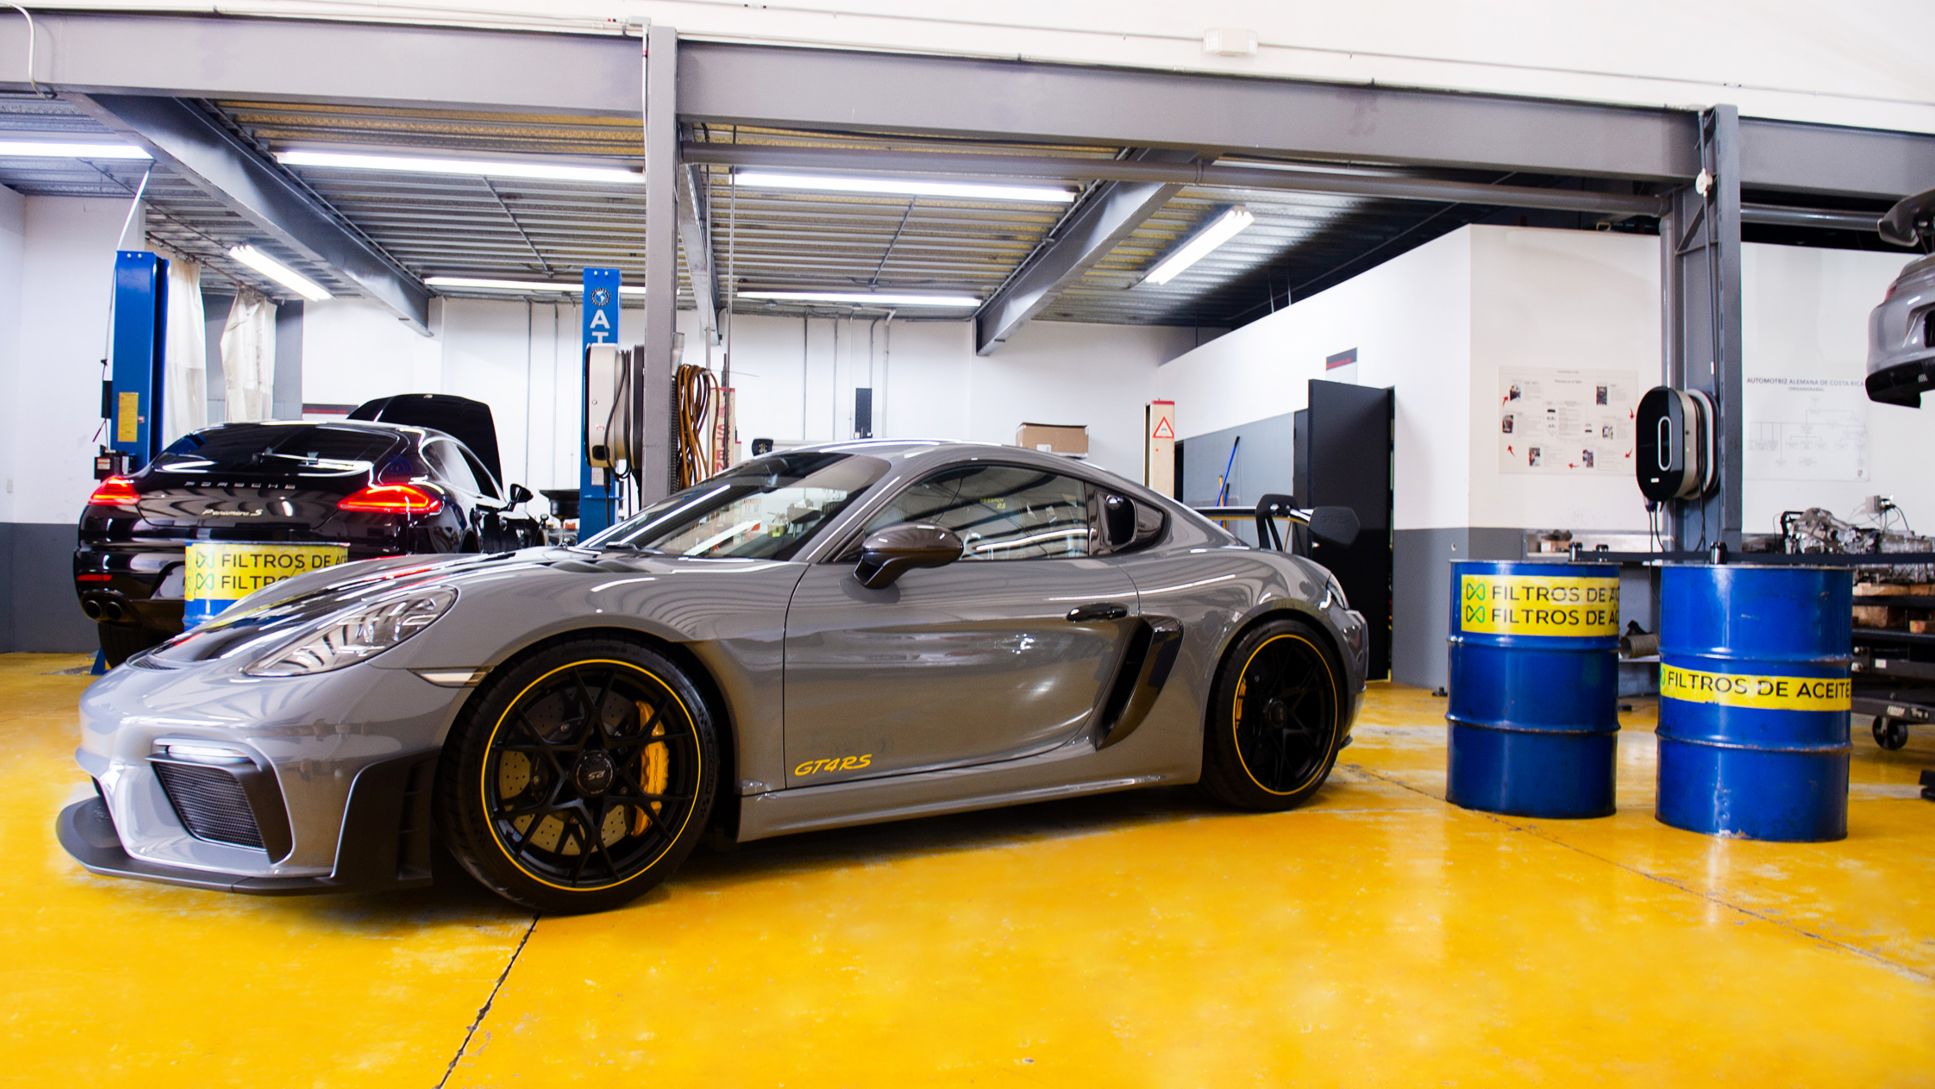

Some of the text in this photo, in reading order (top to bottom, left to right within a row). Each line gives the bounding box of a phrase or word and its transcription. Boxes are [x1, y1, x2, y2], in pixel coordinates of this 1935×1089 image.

[1789, 378, 1819, 386] ALEMANA
[221, 553, 306, 569] FILTROS
[311, 554, 331, 569] DE
[1491, 585, 1580, 603] FILTROS
[1586, 587, 1606, 603] DE
[1491, 608, 1580, 626] FILTROS
[1586, 609, 1606, 626] DE
[1667, 671, 1851, 699] FILTROS DE ACEITE
[794, 753, 872, 777] GT4RS
